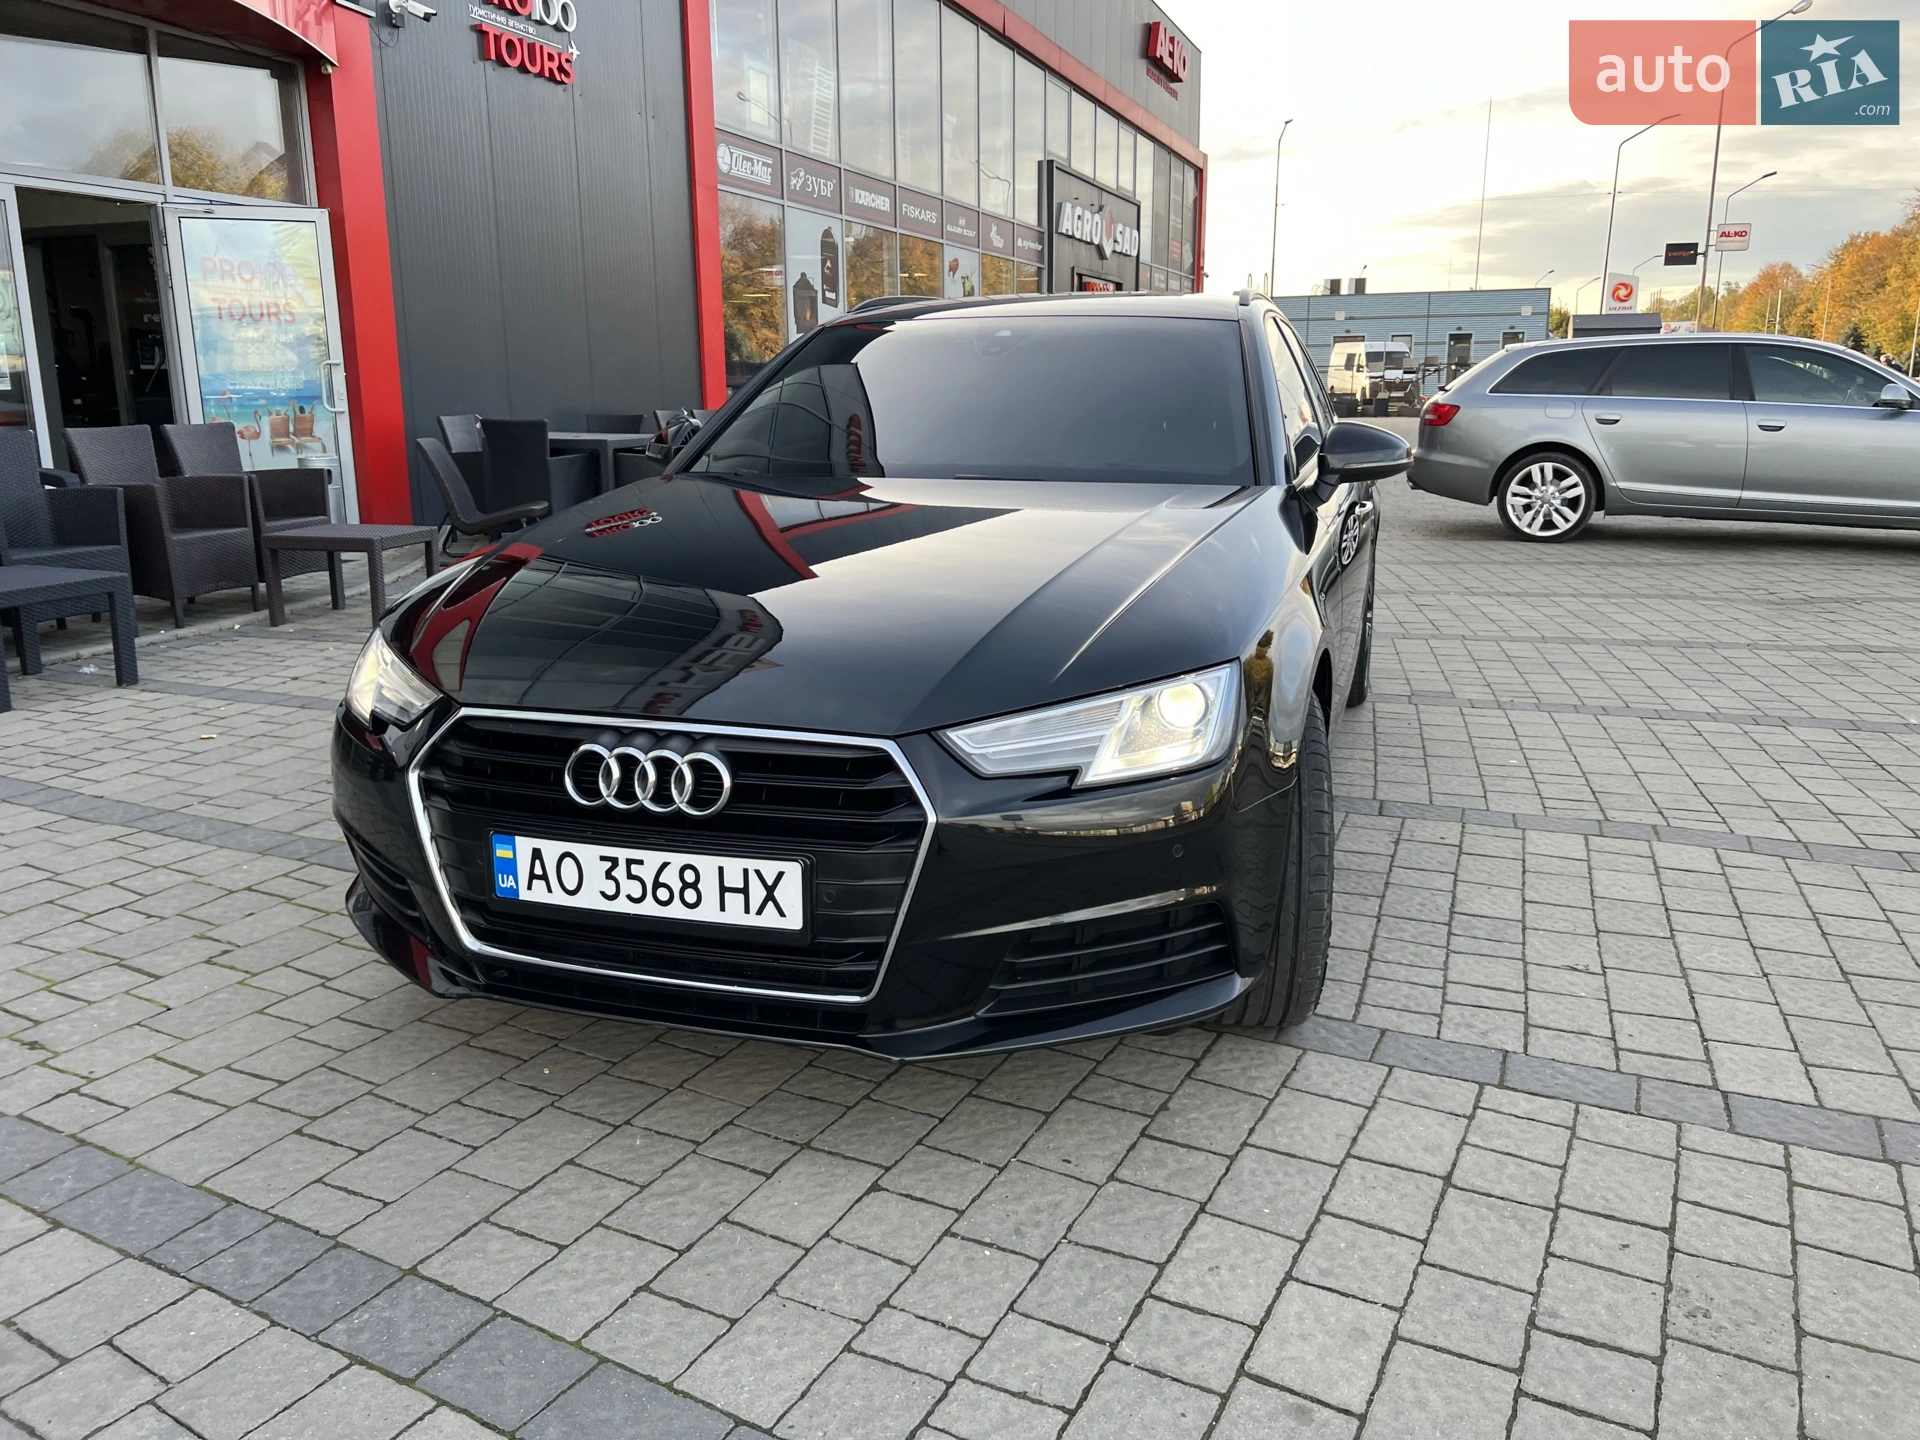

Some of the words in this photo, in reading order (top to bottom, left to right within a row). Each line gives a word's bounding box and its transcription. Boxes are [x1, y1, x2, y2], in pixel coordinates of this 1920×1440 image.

[477, 23, 576, 84] TOURS
[805, 174, 834, 198] ЗУБР
[902, 203, 937, 224] FISKARS
[1058, 202, 1102, 245] AGRO
[1115, 223, 1139, 257] SAD
[211, 296, 297, 324] TOURS
[498, 873, 517, 890] UA
[526, 847, 584, 897] AO
[599, 855, 703, 909] 3568
[717, 866, 787, 918] HX
